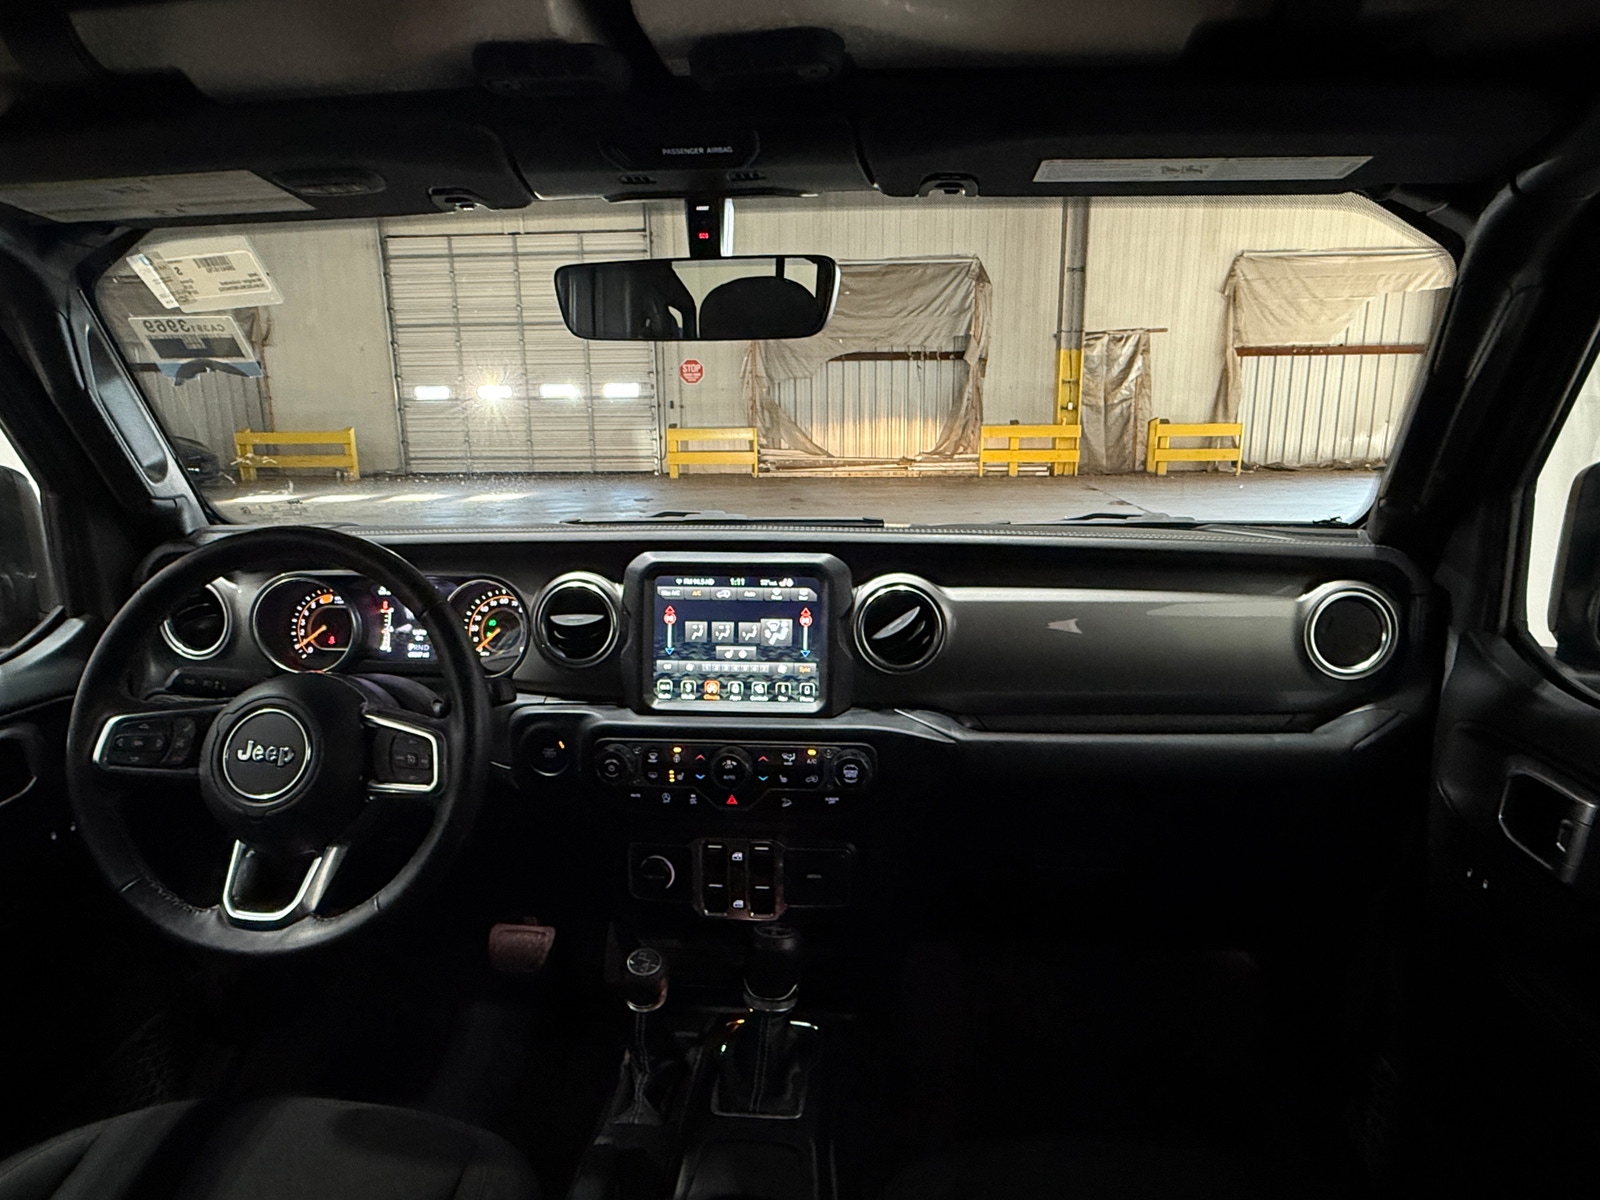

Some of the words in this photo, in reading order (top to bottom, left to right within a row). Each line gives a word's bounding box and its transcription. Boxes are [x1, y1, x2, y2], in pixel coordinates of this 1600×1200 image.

[707, 146, 734, 154] AIRBAG
[682, 364, 701, 373] STOP
[730, 578, 745, 586] 1:11
[237, 740, 295, 766] Jeep
